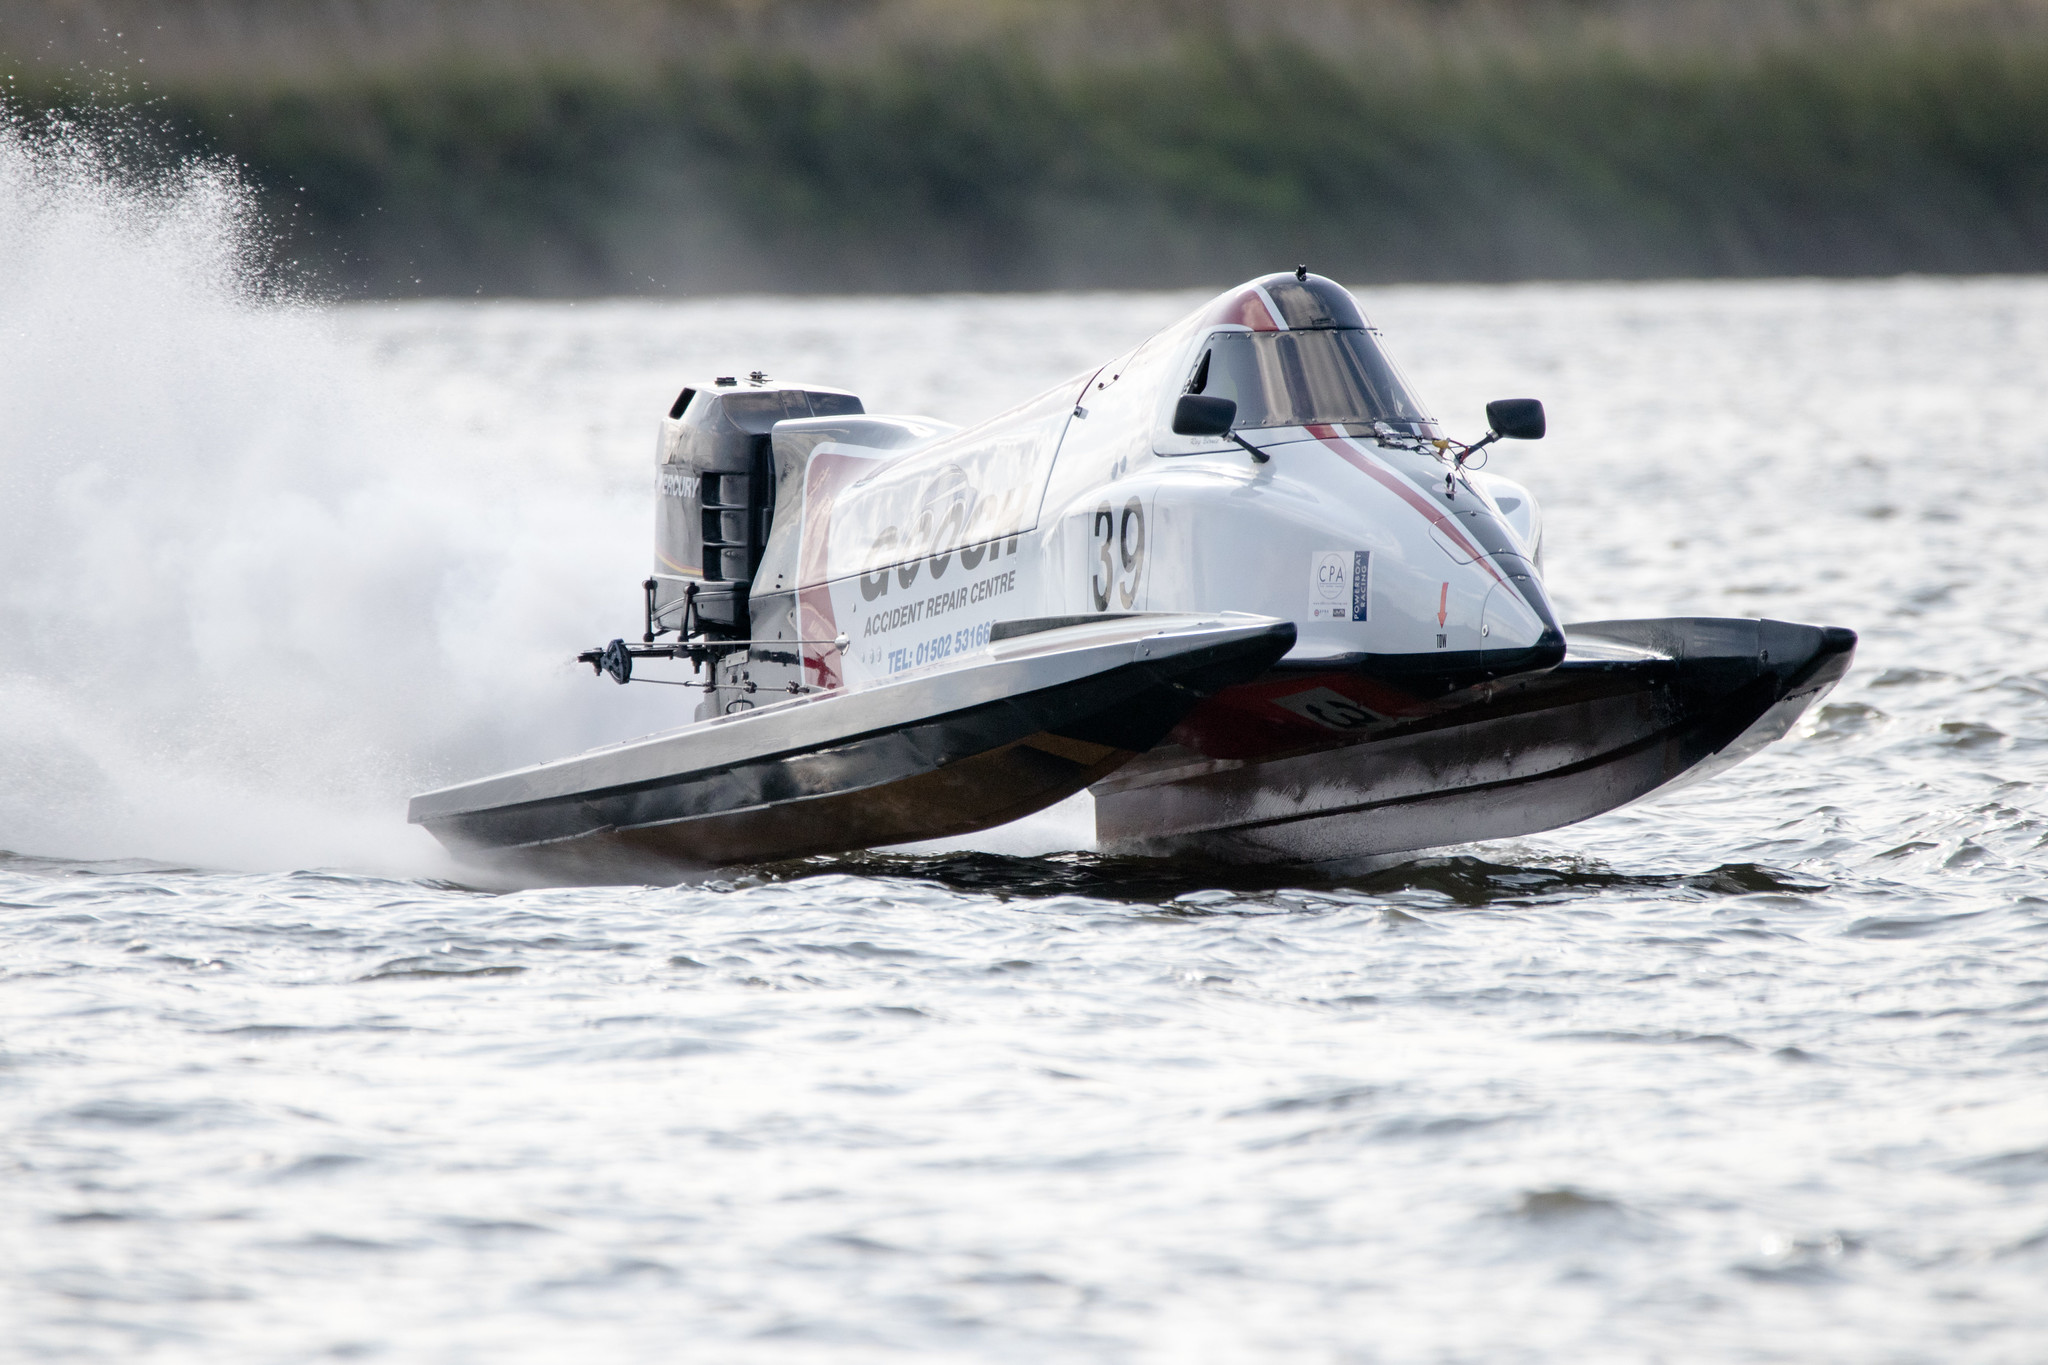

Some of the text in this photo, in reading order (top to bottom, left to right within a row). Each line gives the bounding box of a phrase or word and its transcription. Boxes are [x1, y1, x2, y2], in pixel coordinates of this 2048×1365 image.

[1092, 495, 1145, 612] 39
[1318, 565, 1344, 583] CPA
[863, 569, 1016, 638] ACCIDENT REPAIR CENTRE
[1353, 553, 1362, 620] POWERBOAT
[887, 619, 997, 675] TEL: 01502 53166
[1436, 633, 1447, 649] TOW
